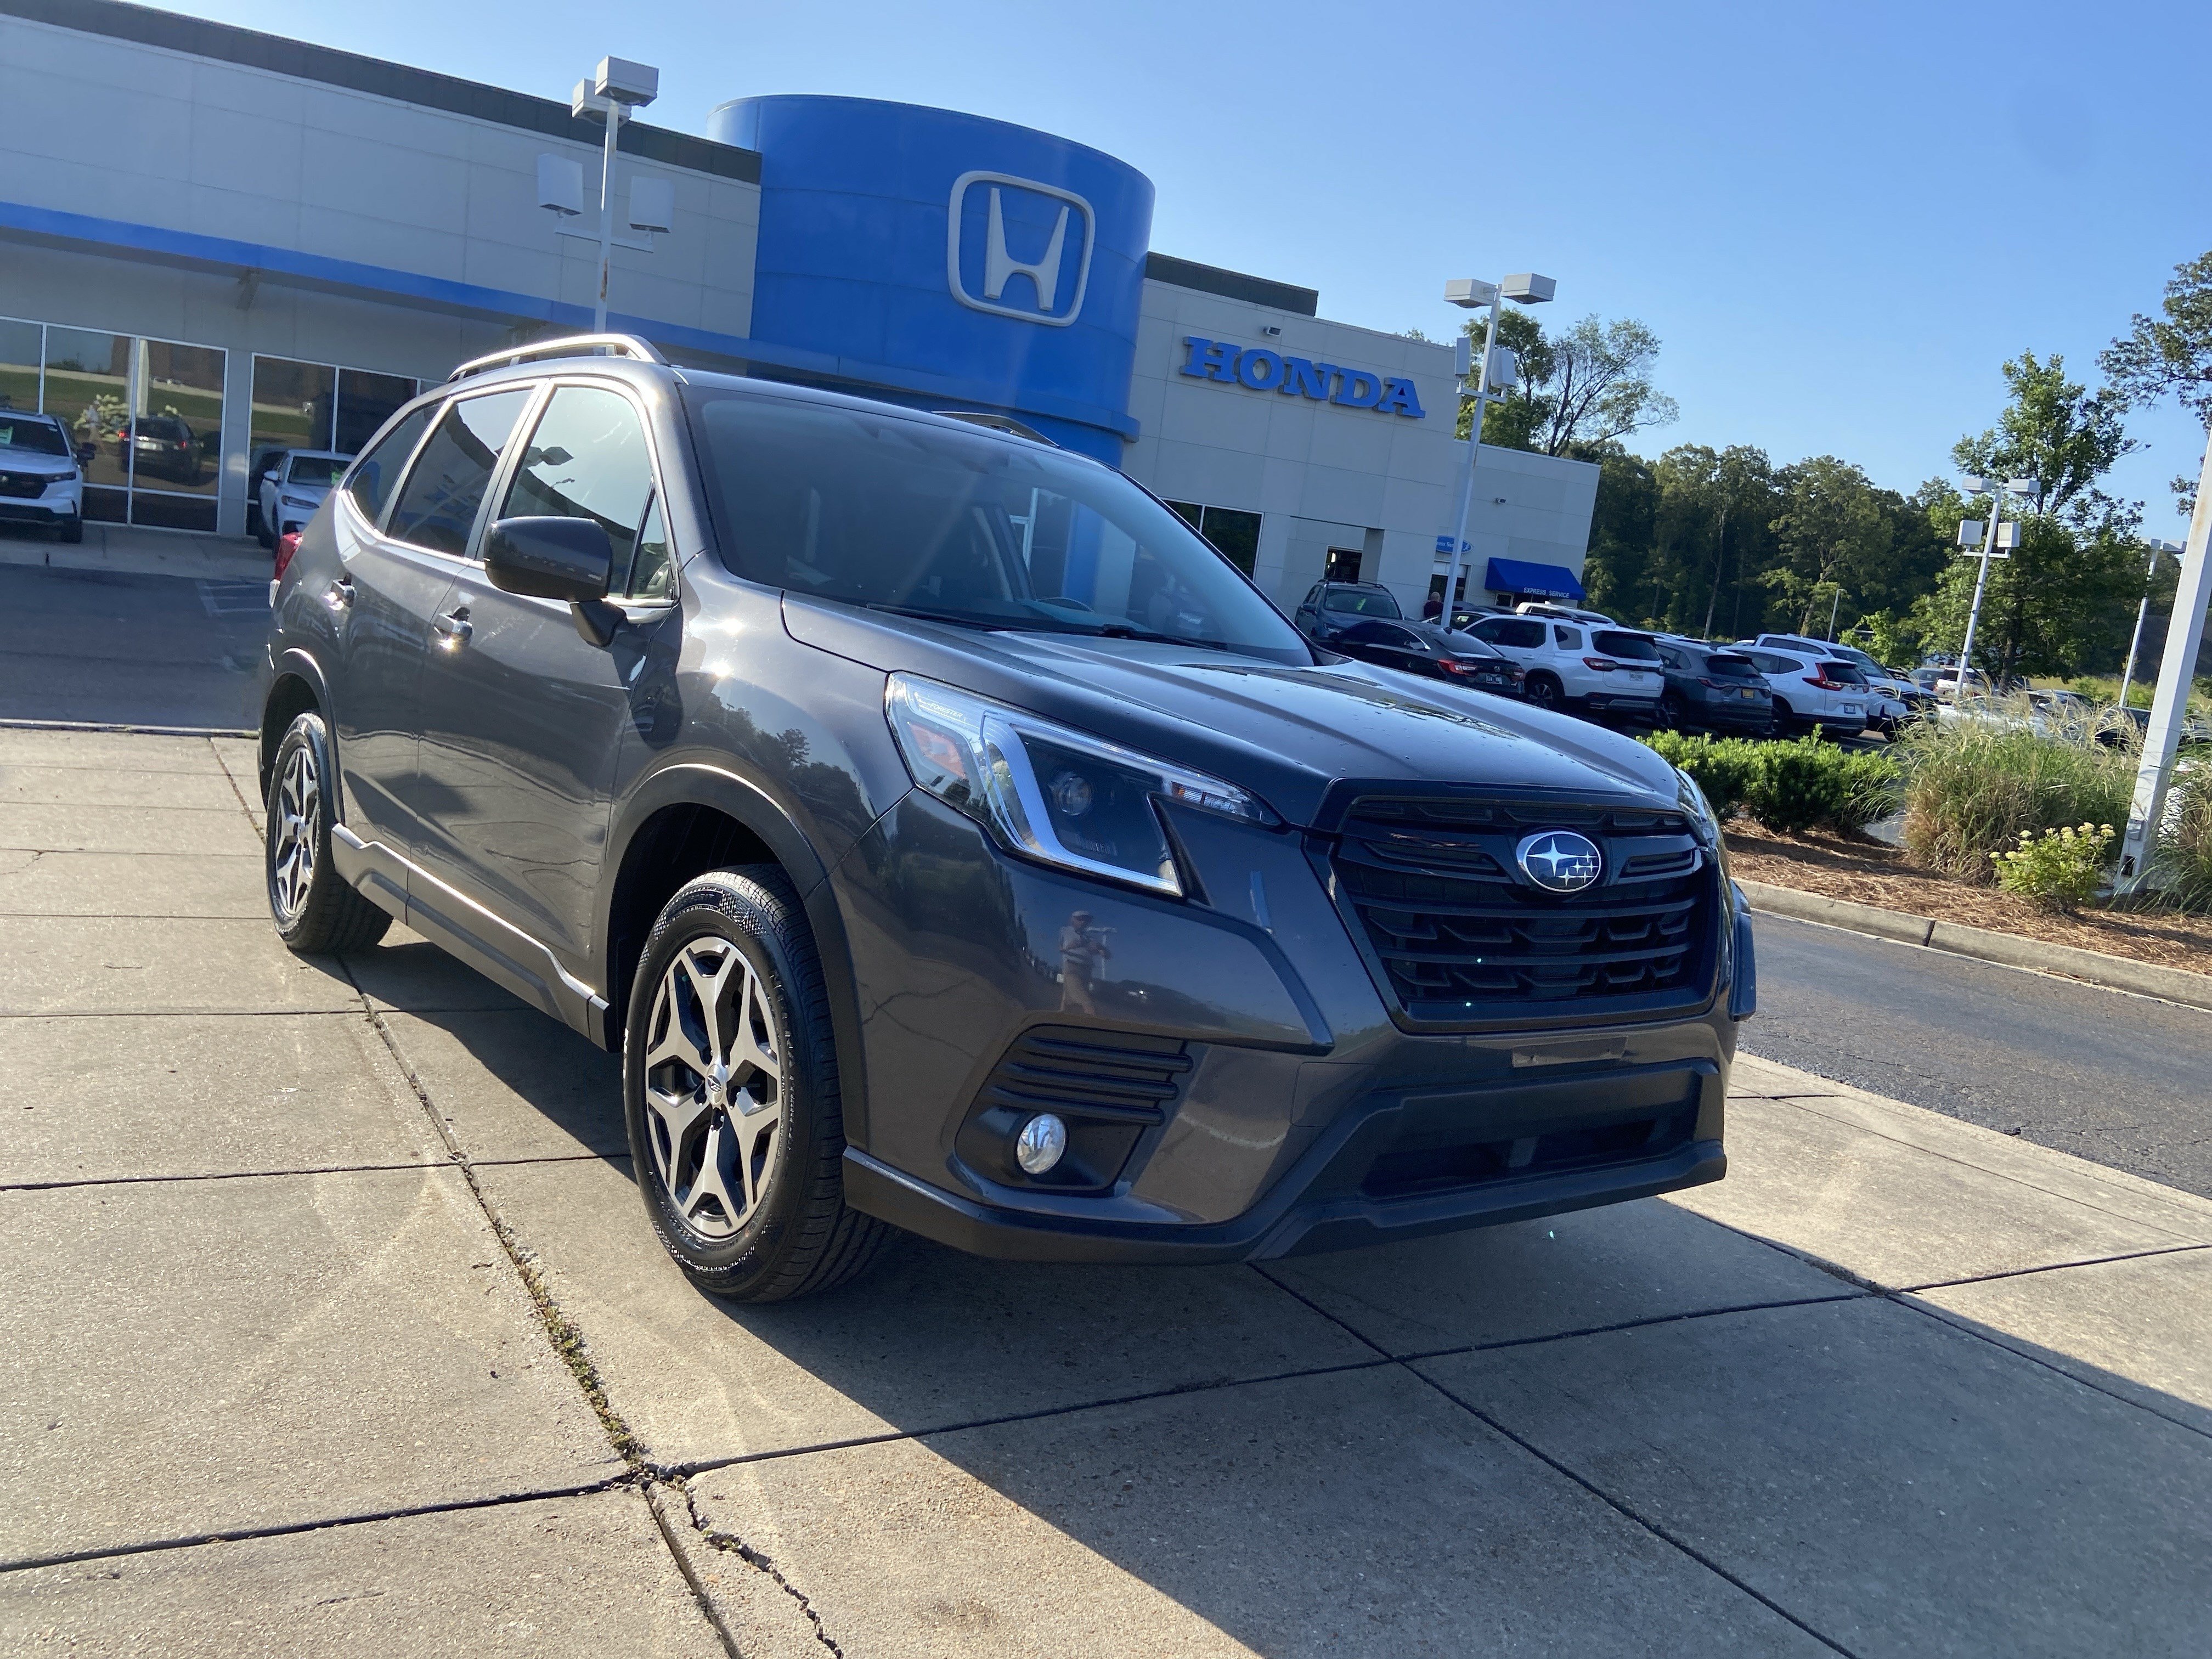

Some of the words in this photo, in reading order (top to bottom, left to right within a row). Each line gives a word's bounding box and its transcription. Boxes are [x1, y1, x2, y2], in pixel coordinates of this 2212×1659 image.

[1179, 336, 1426, 419] HONDA
[1523, 587, 1547, 595] EXPRESS
[1549, 590, 1570, 598] SERVICE
[930, 703, 963, 718] FORESTER
